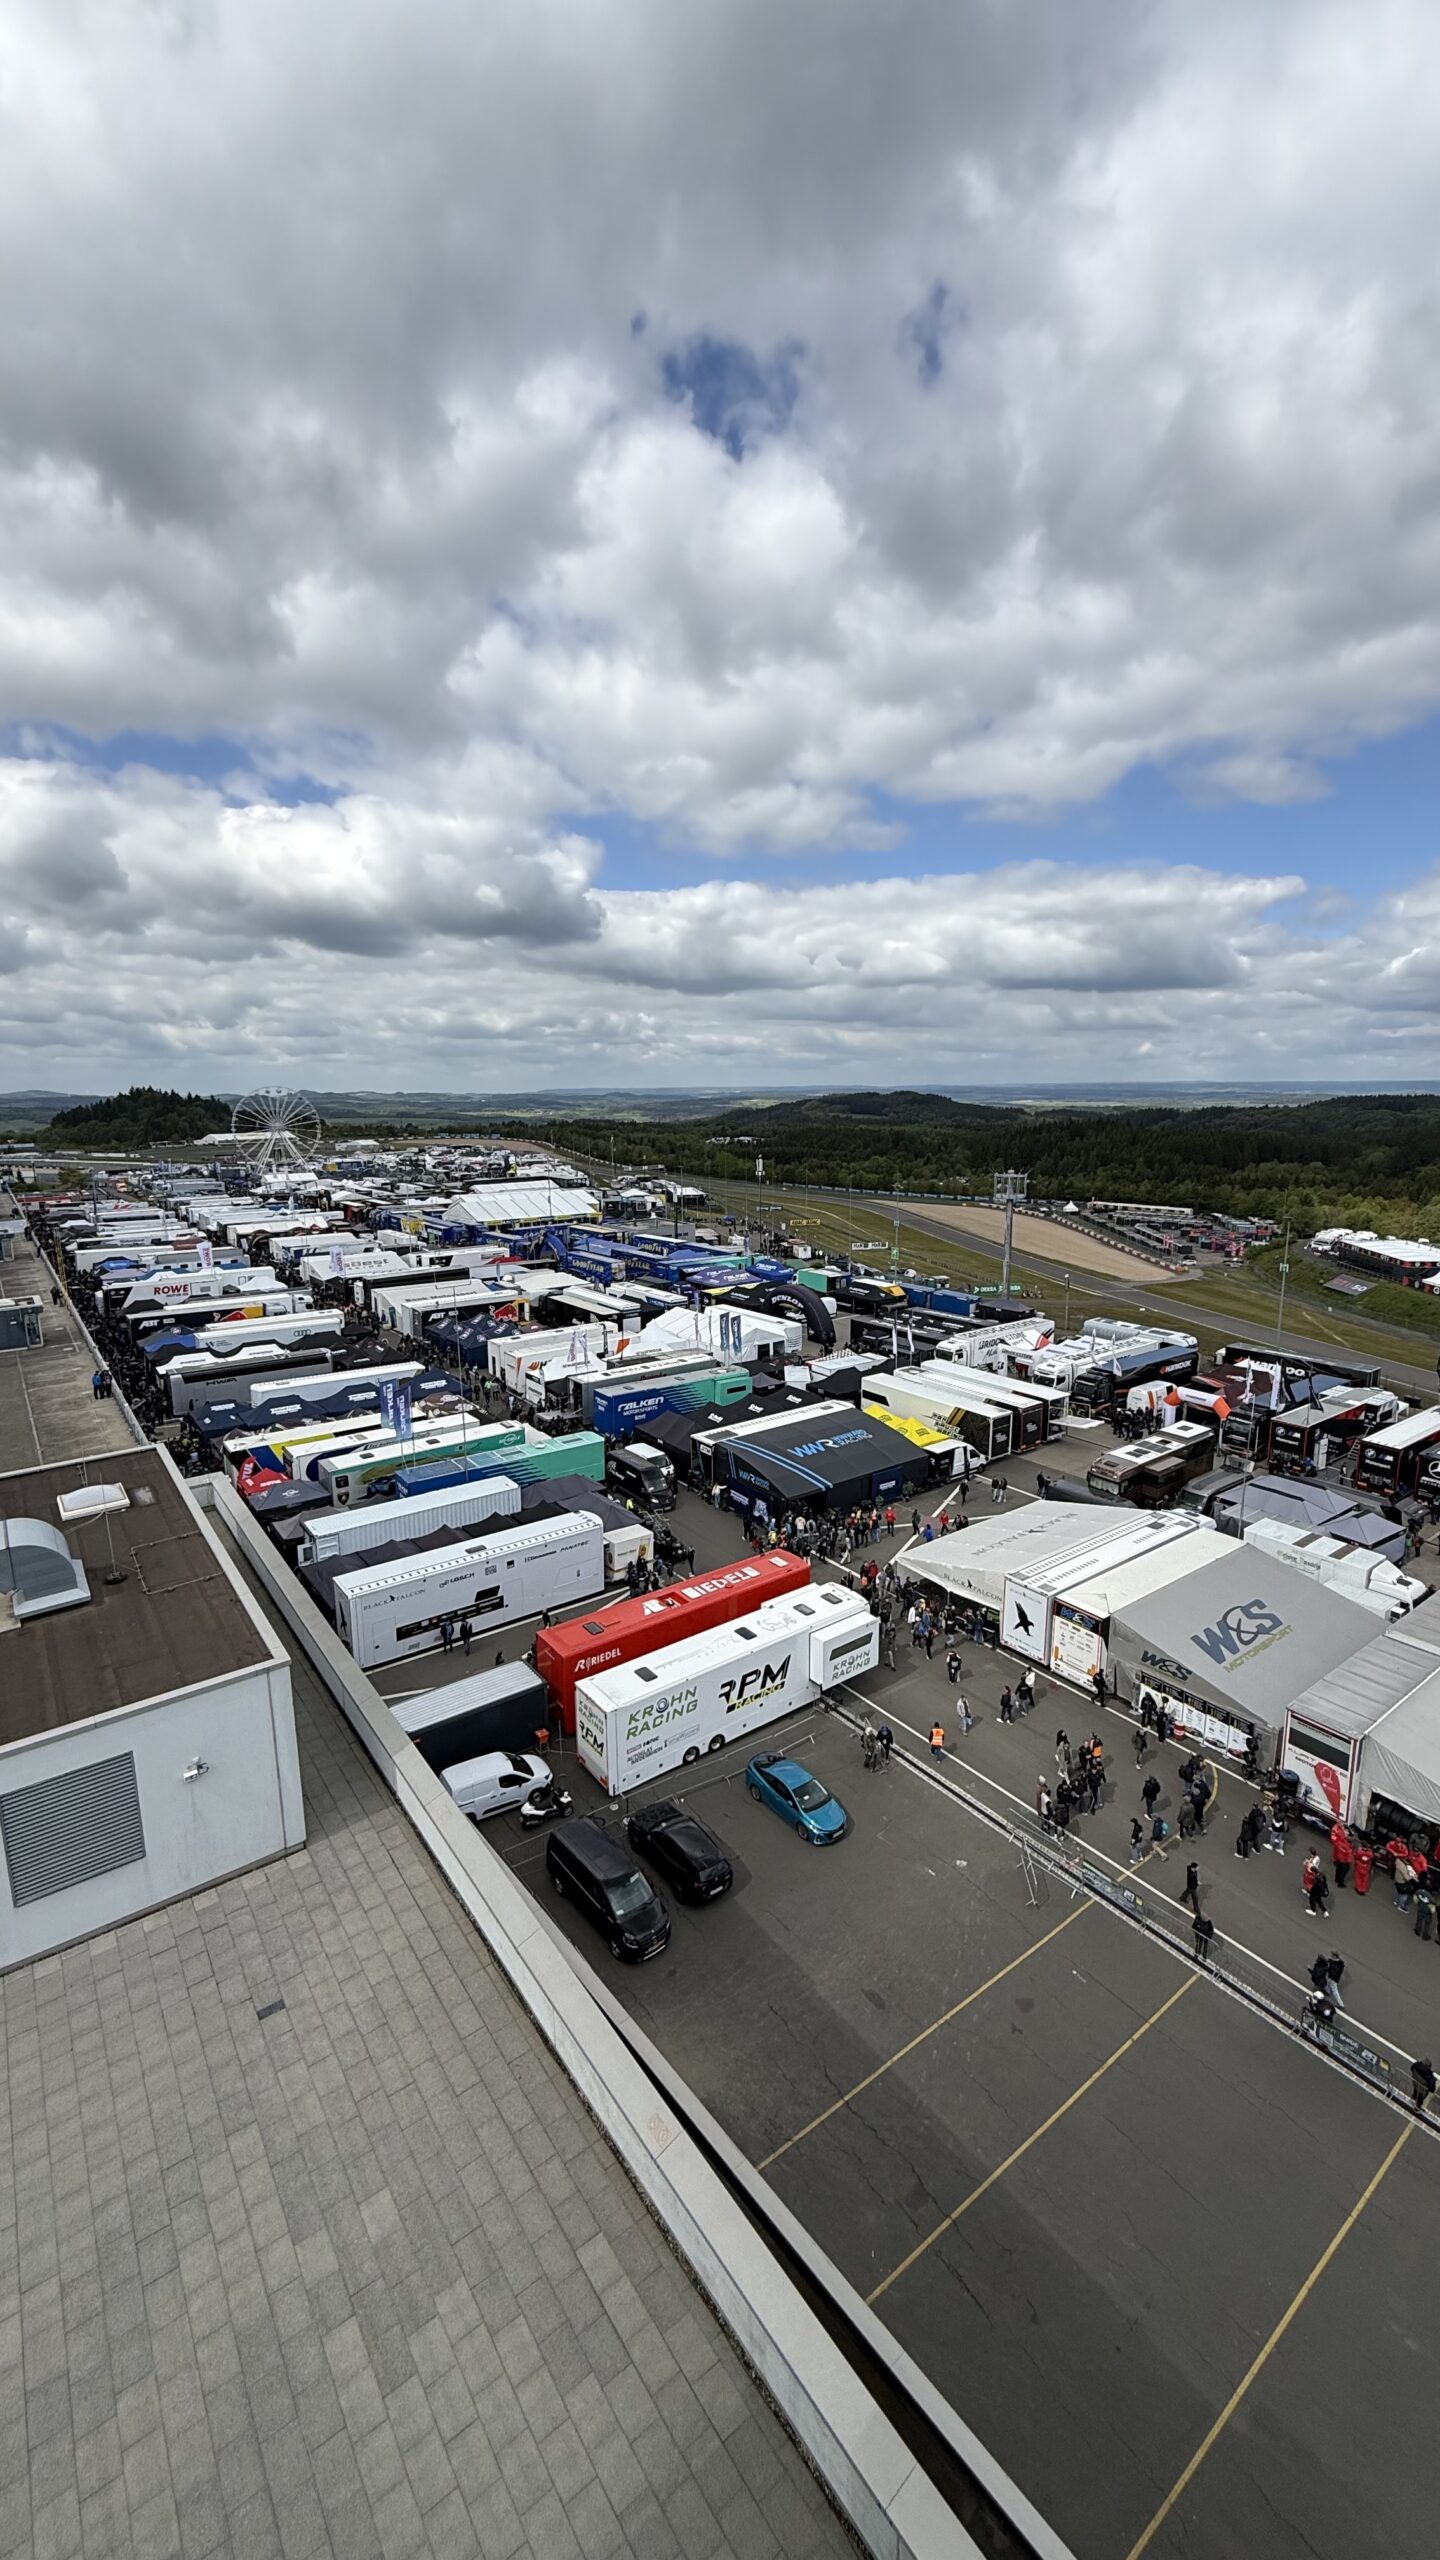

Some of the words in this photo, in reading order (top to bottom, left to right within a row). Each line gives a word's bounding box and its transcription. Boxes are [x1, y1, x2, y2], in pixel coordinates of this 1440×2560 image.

[572, 1258, 605, 1273] GOODYEAR
[153, 1284, 189, 1296] ROWE
[771, 1295, 805, 1309] DUNLOP
[139, 1319, 160, 1330] ABT
[206, 1378, 237, 1387] HWA
[617, 1396, 664, 1412] FALKEN
[560, 1539, 590, 1552] FANATEC
[943, 1573, 966, 1586] BLACK
[363, 1599, 389, 1611] BLACK
[397, 1588, 426, 1602] FALCON
[1060, 1606, 1096, 1630] W&S
[1190, 1599, 1284, 1665] W&S
[590, 1647, 622, 1667] RIEDEL
[833, 1649, 871, 1672] KROHN
[1223, 1625, 1293, 1673] MOTORSPORT
[831, 1657, 871, 1681] RACING
[1142, 1649, 1192, 1682] W&S
[718, 1654, 792, 1704] RPM
[628, 1685, 697, 1725] KROHN
[734, 1681, 786, 1710] RACING
[626, 1699, 698, 1740] RACING
[579, 1719, 605, 1751] RPM
